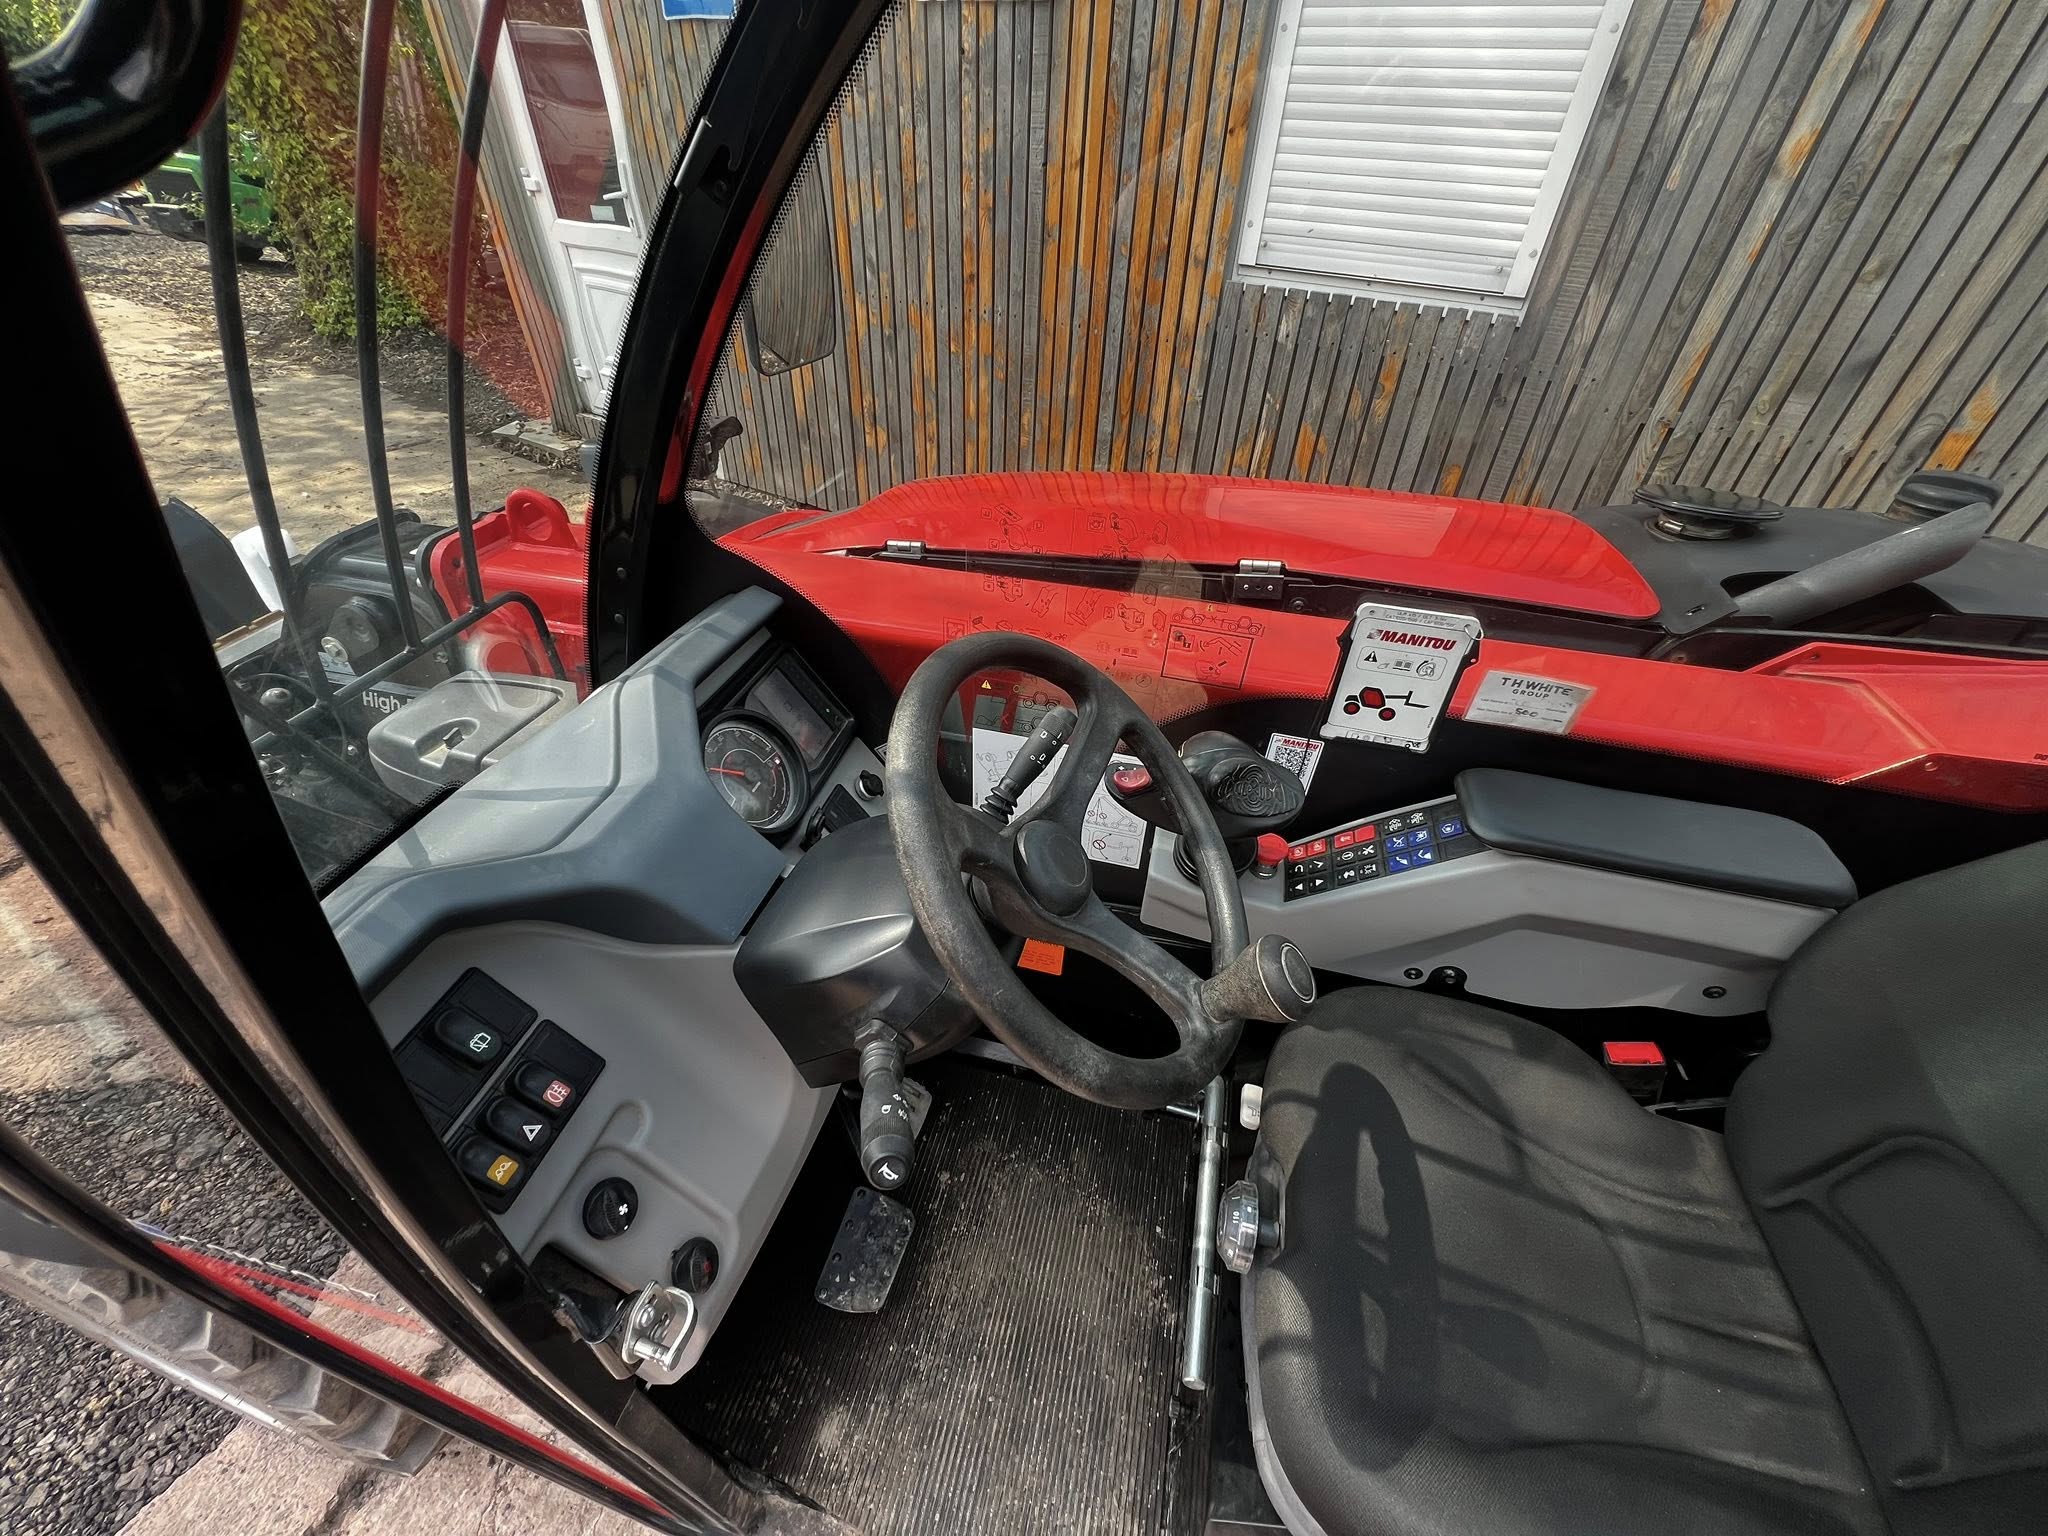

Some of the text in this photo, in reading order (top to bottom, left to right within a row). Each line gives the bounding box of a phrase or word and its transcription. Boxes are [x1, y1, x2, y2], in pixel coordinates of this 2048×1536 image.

[1380, 629, 1457, 651] MANITOU
[1512, 688, 1550, 699] GROUP
[1526, 680, 1573, 696] WHITE
[362, 691, 401, 714] High
